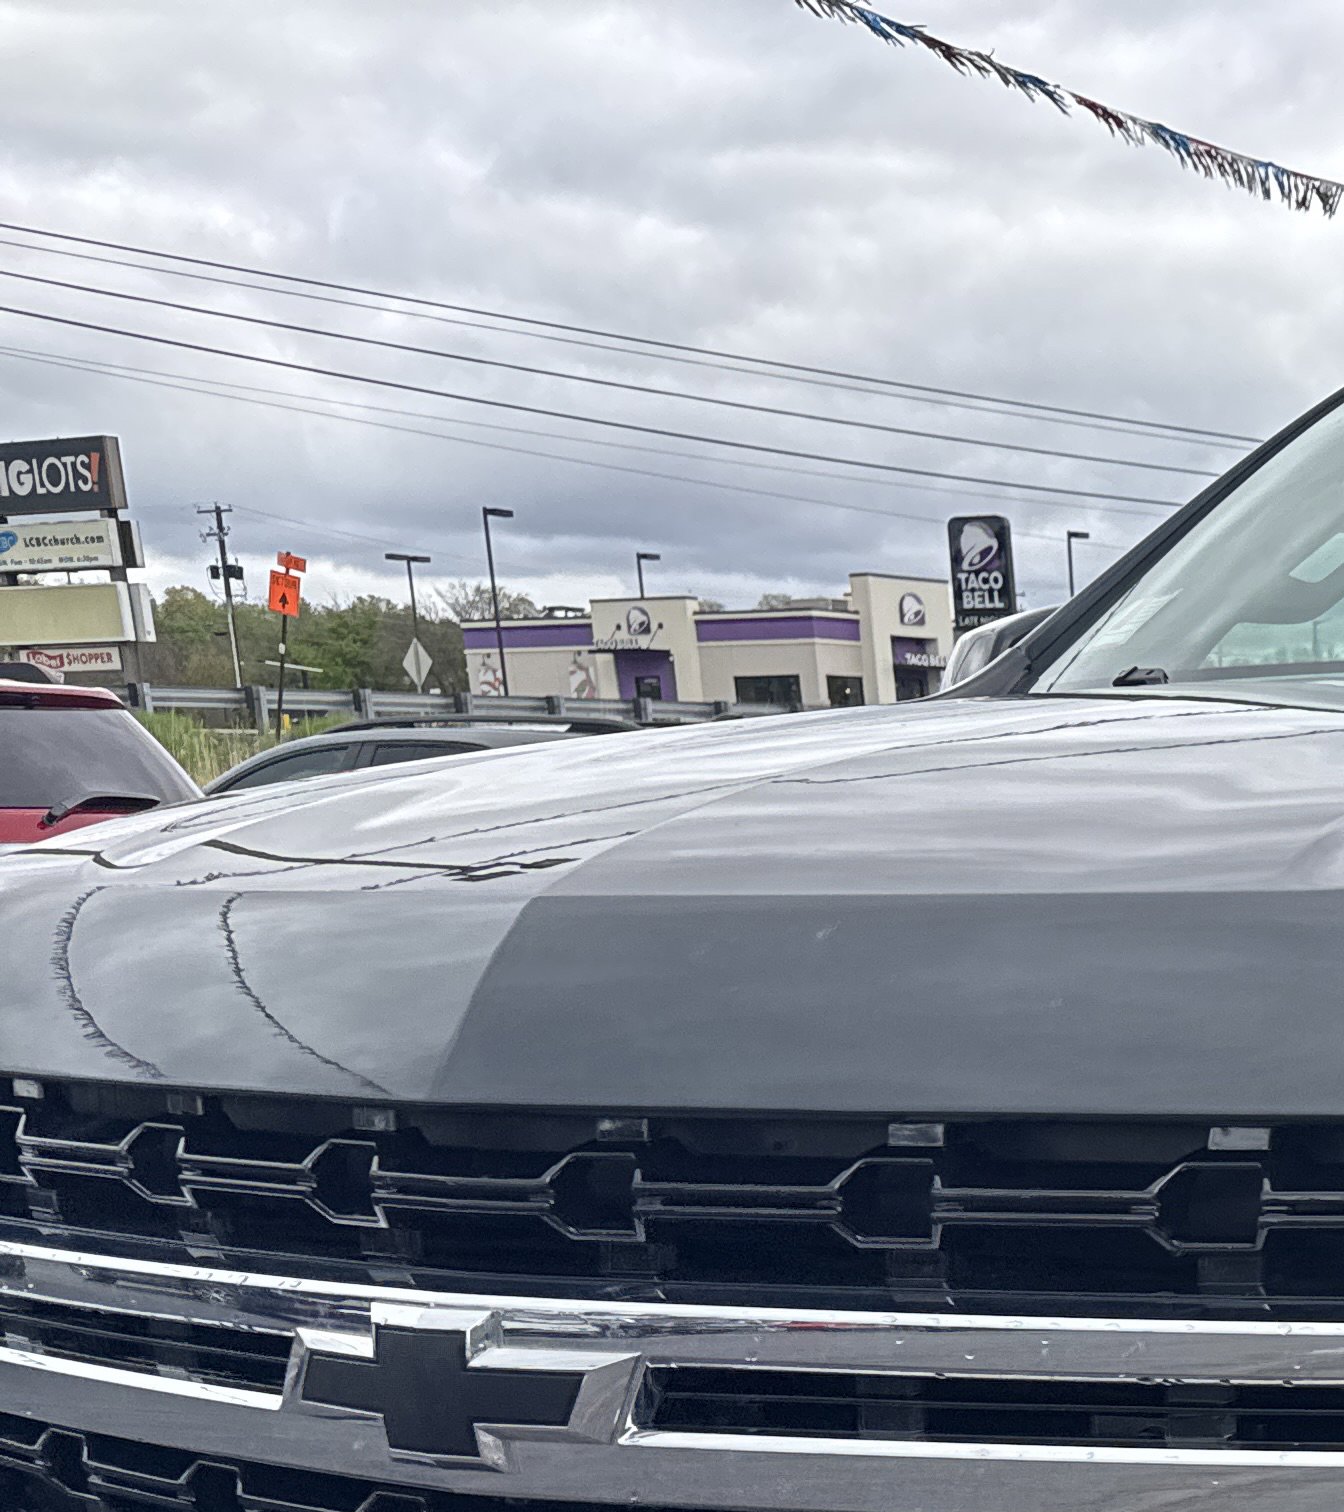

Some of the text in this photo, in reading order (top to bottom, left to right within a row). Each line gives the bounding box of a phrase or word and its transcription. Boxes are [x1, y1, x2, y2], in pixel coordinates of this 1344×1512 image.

[23, 533, 105, 548] LCBCchurch.com
[957, 571, 1003, 590] TACO
[962, 590, 1005, 609] BELL
